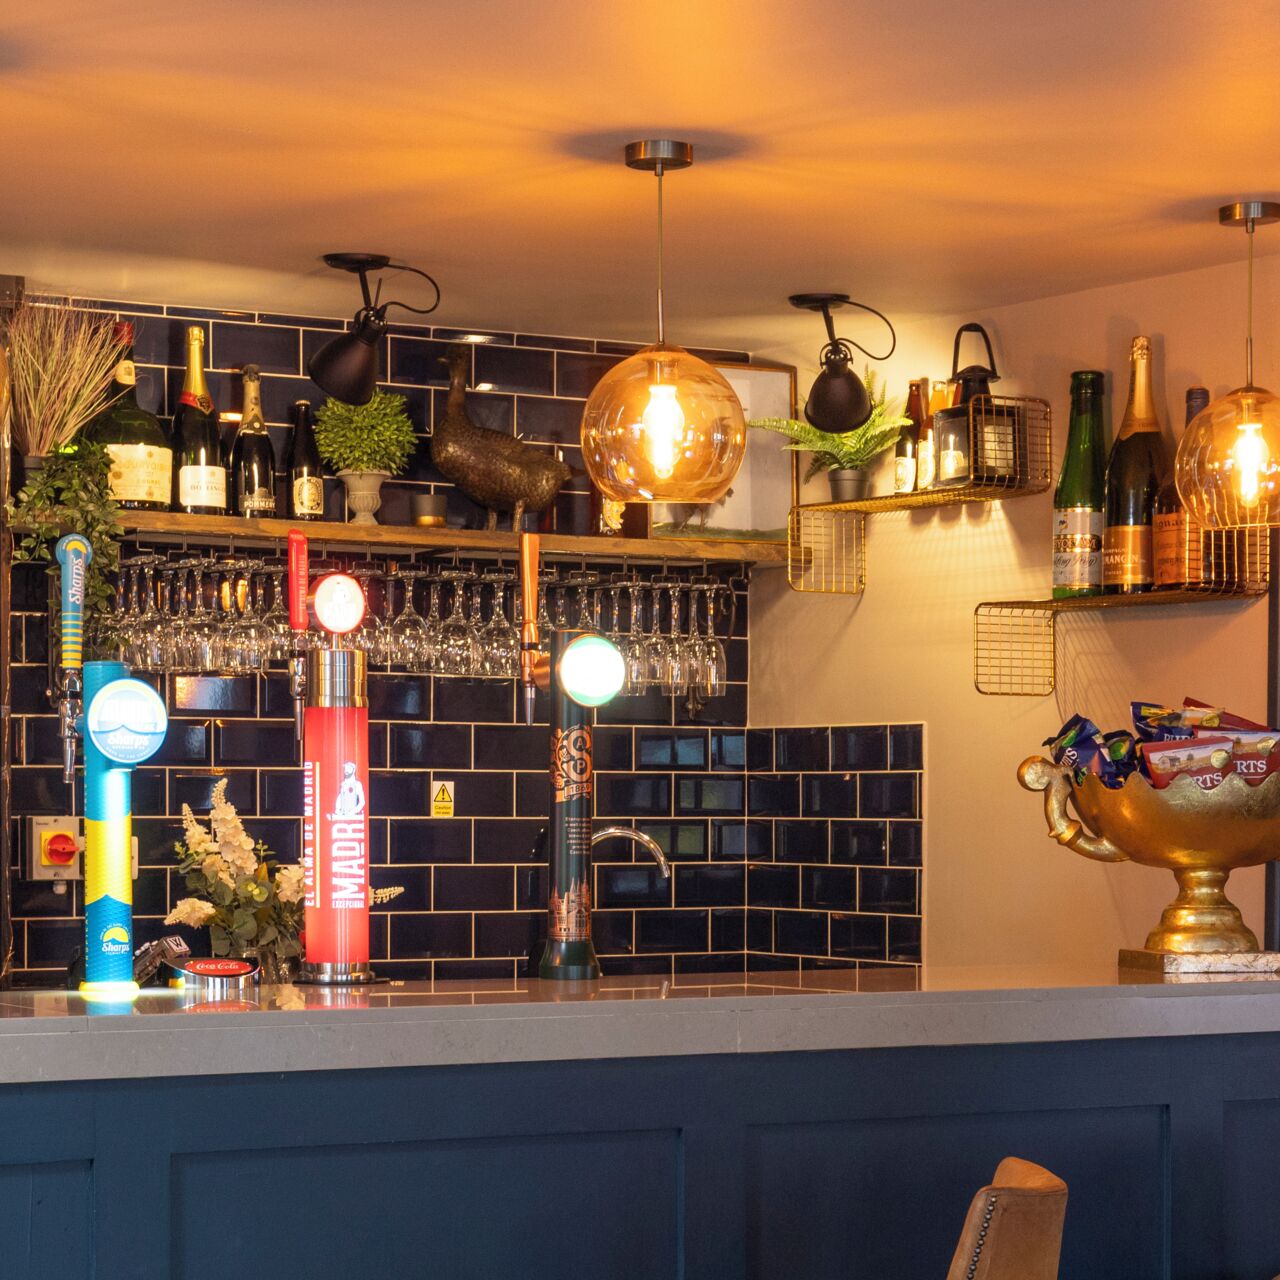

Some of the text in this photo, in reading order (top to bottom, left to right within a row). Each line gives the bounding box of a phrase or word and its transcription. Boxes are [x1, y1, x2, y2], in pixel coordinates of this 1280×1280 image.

[1233, 760, 1267, 773] RTS
[1193, 772, 1223, 788] RTS
[304, 761, 314, 907] EL ALMA DE MADRID
